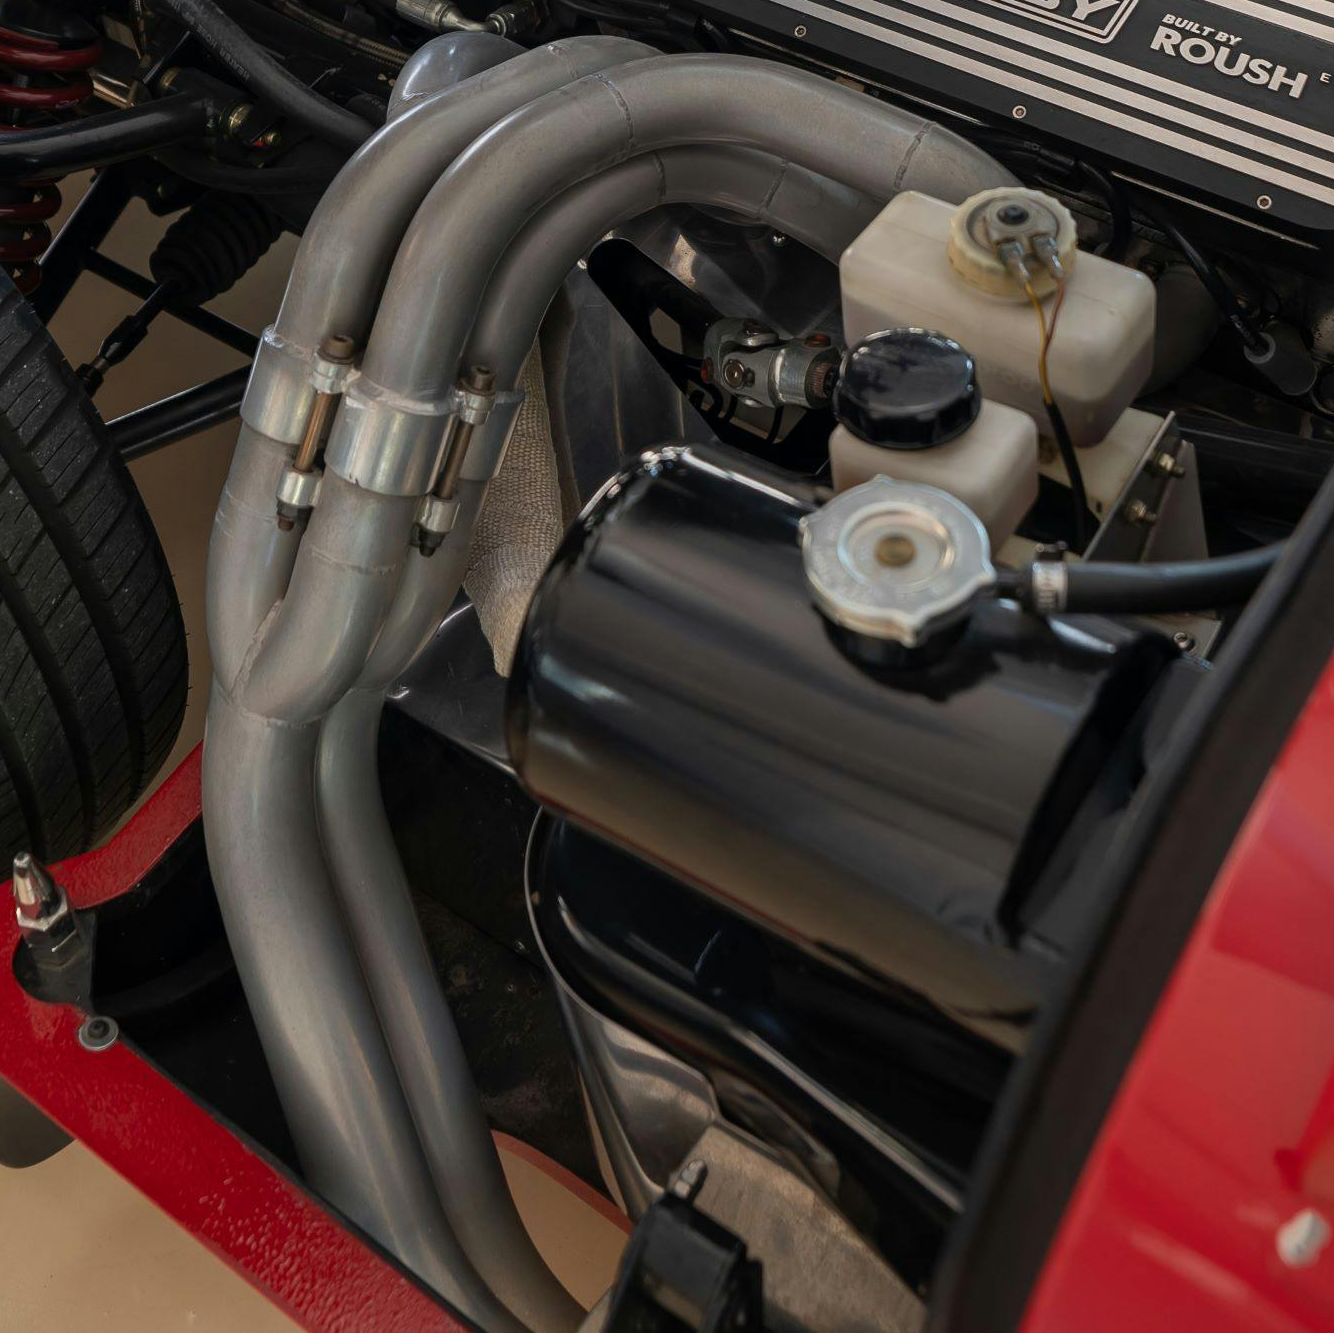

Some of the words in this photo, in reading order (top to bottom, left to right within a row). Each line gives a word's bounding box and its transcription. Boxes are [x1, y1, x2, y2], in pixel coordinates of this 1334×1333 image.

[1162, 13, 1212, 39] BUILT
[1212, 30, 1242, 47] BY
[1150, 24, 1309, 98] ROUSH
